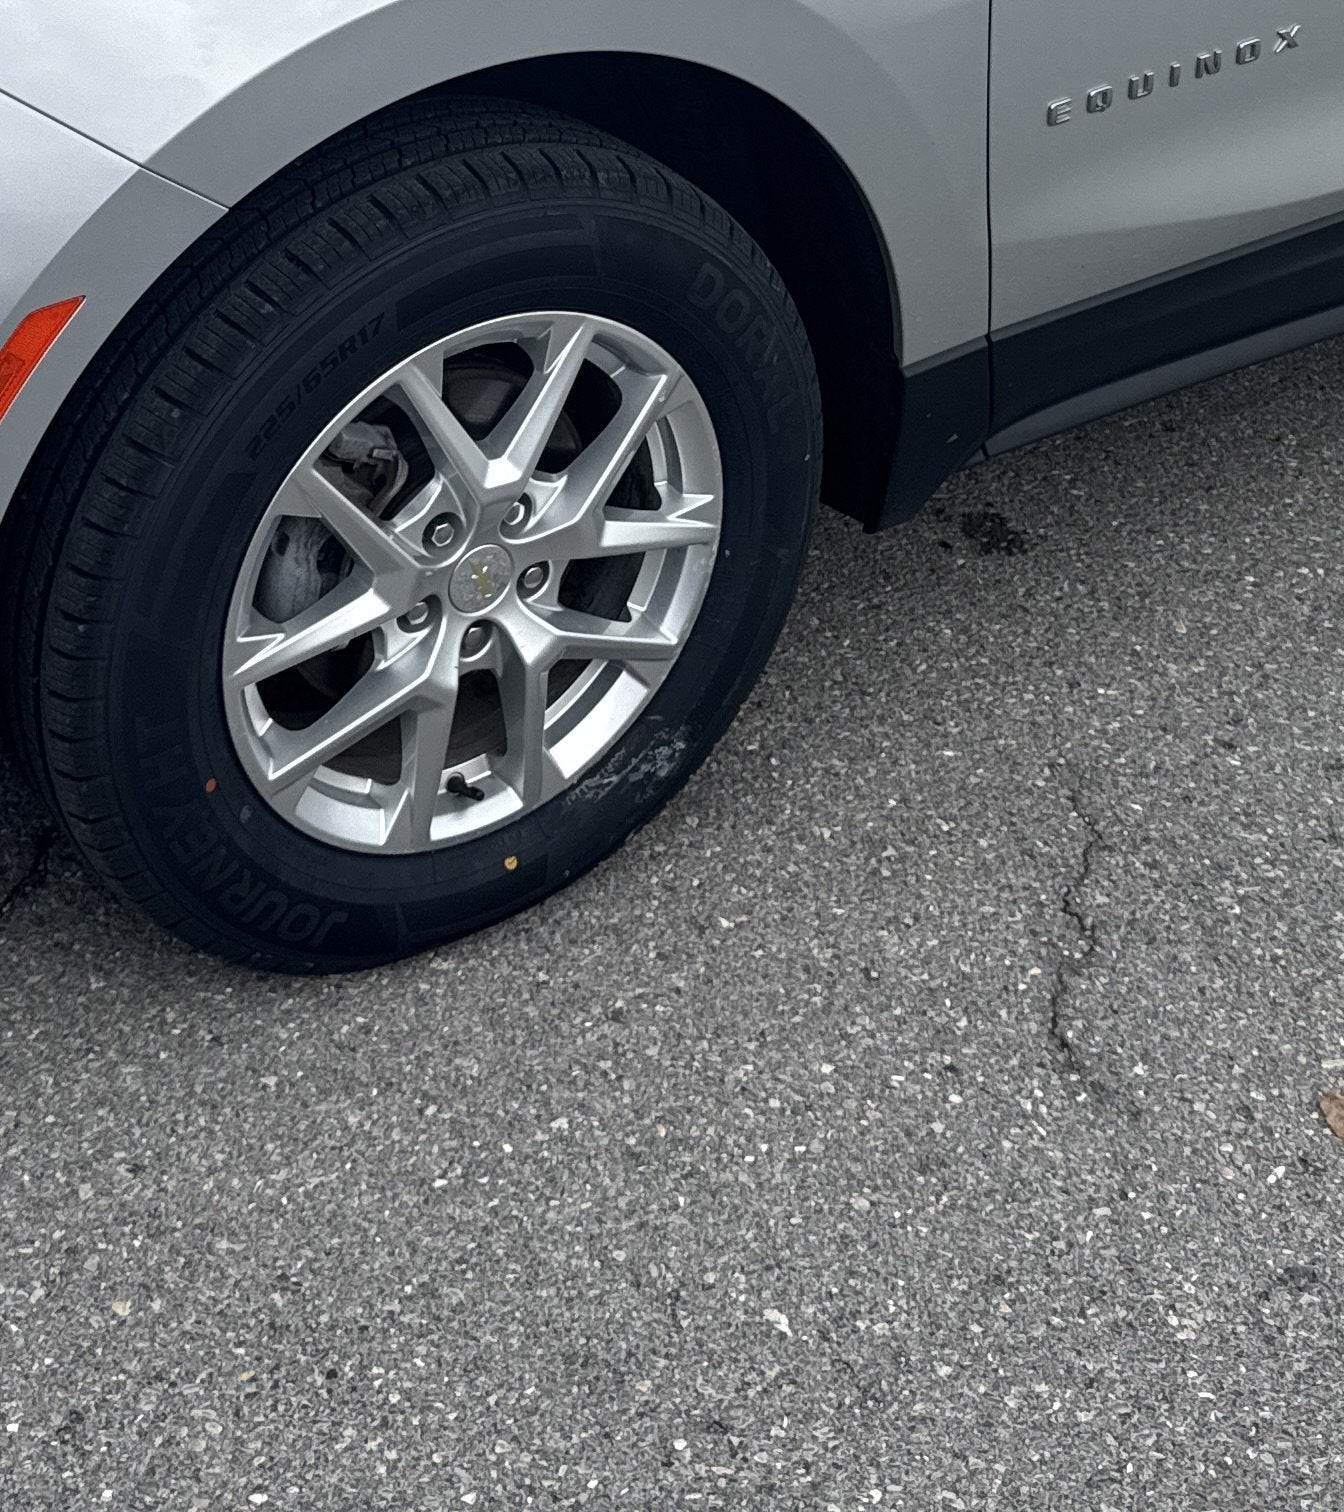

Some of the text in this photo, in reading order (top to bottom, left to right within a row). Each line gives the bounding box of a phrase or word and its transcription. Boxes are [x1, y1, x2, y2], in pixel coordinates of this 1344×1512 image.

[1046, 23, 1301, 126] EQUINOX
[244, 310, 386, 461] 225/65R17
[686, 261, 799, 435] DORAL
[150, 798, 351, 948] JOURNEY
